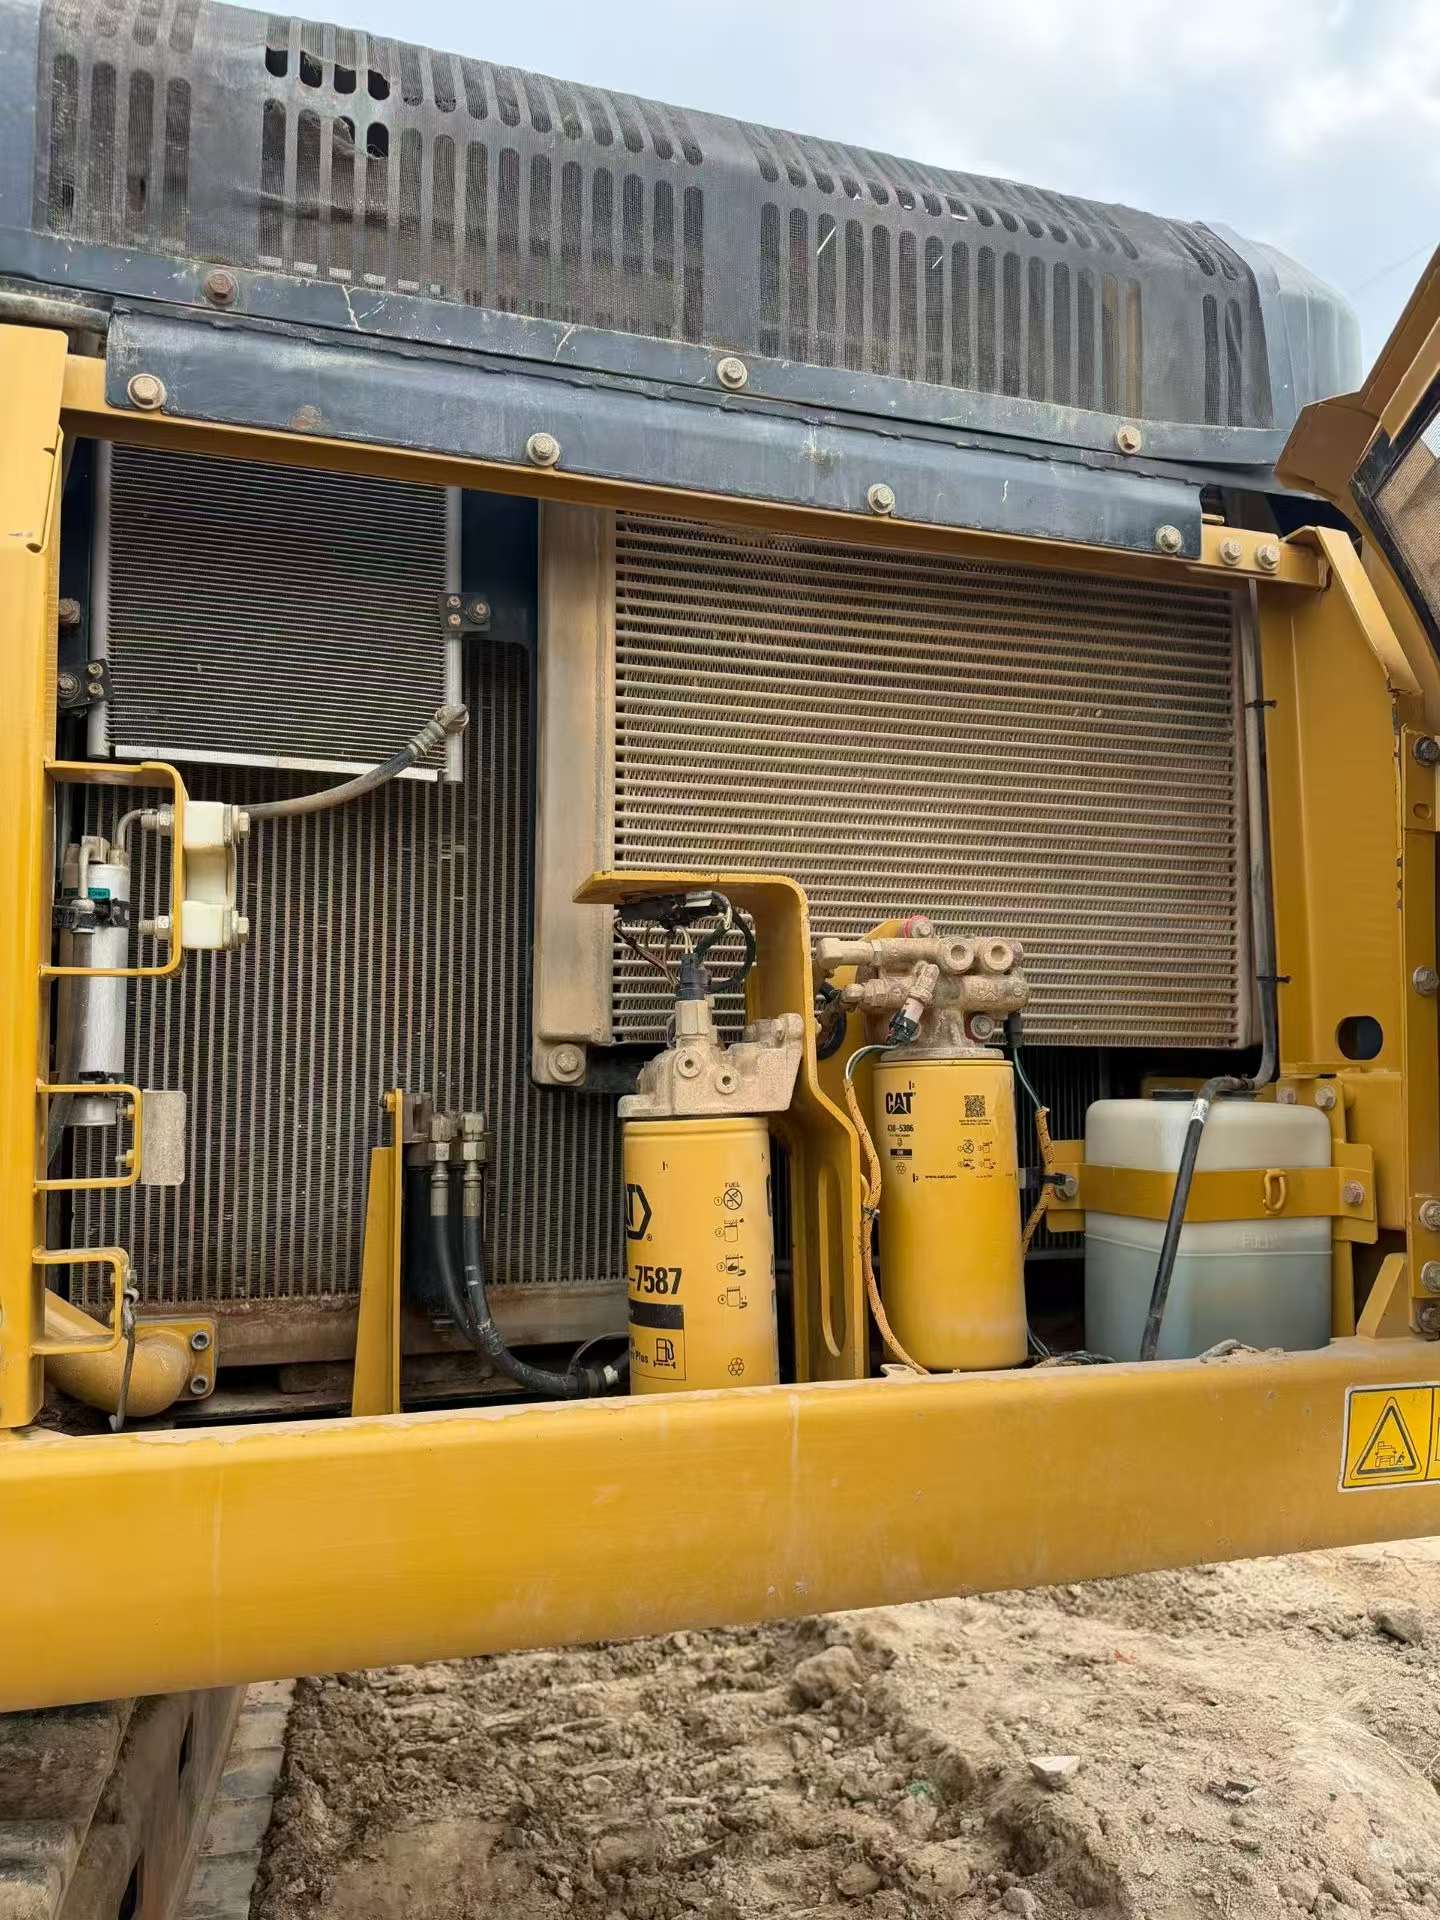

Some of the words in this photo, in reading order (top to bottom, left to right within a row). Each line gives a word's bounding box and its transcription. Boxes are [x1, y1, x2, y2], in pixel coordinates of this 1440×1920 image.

[885, 1092, 913, 1115] CAT
[629, 1264, 682, 1295] -7587
[635, 1350, 649, 1364] Plus
